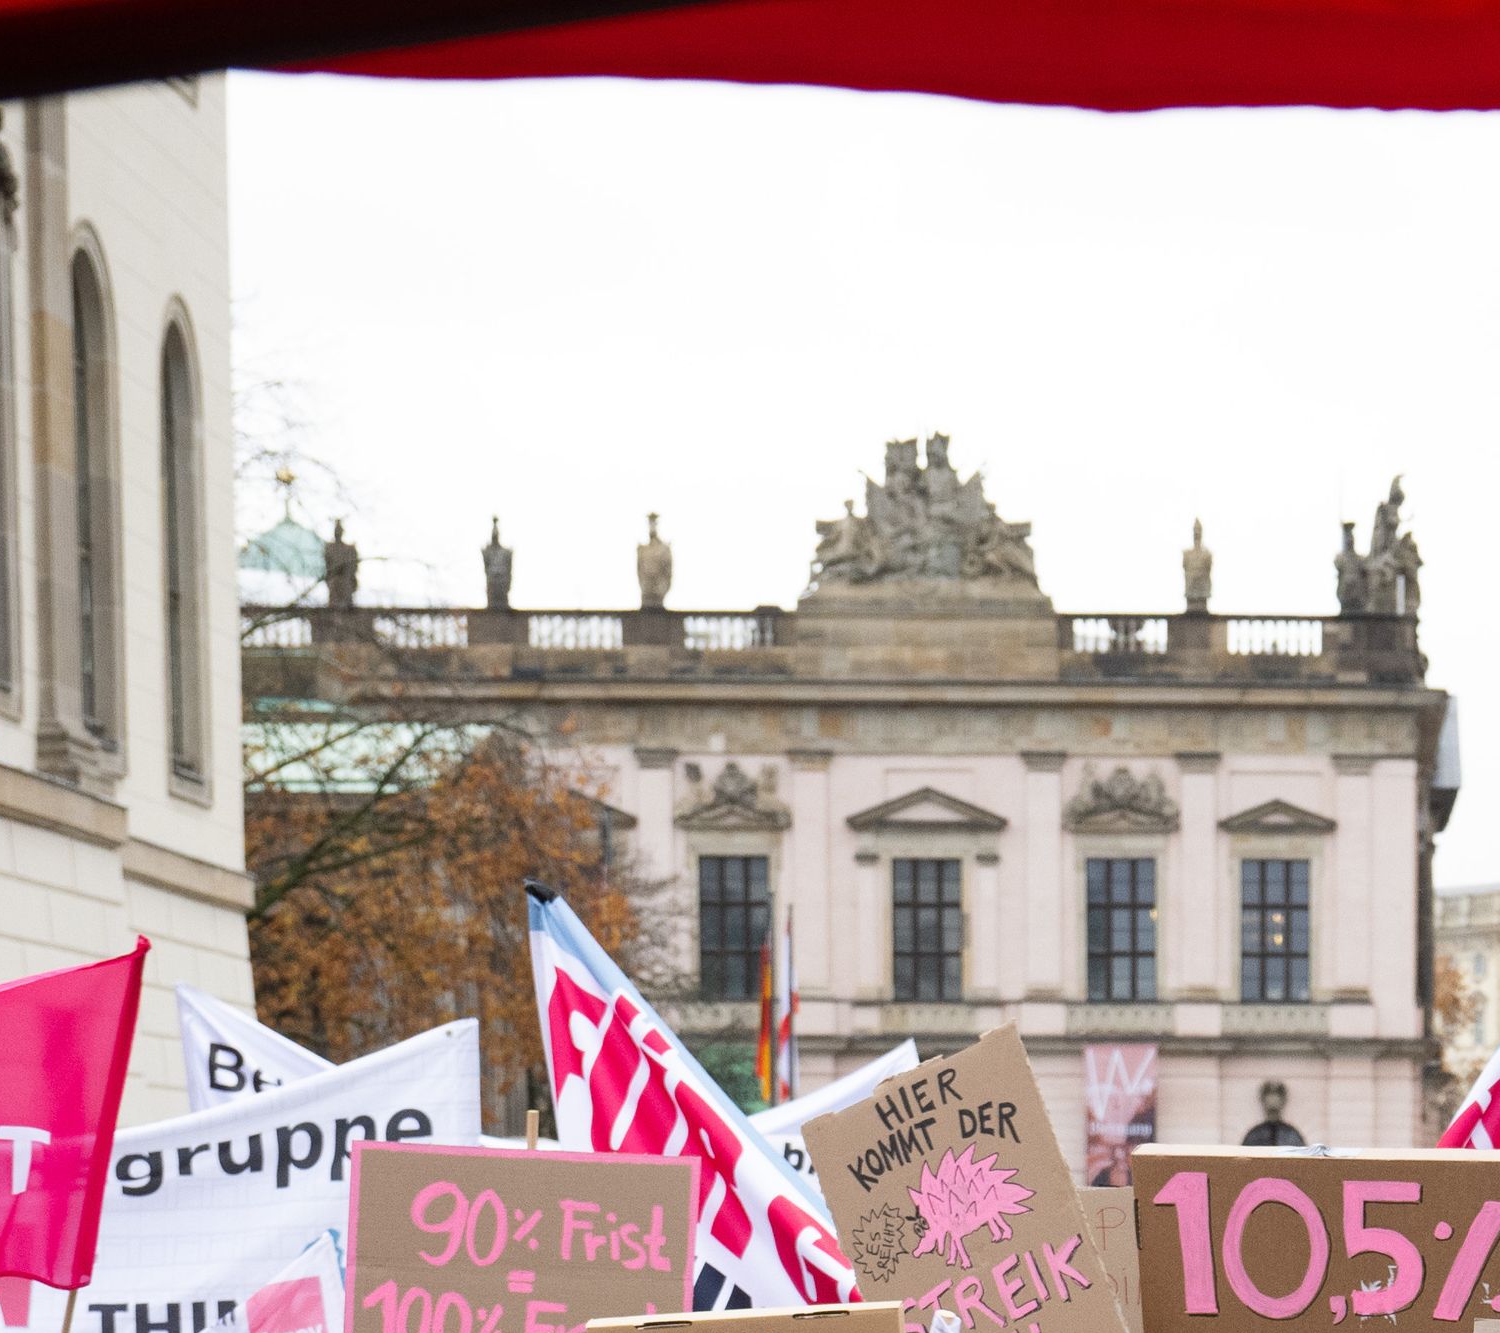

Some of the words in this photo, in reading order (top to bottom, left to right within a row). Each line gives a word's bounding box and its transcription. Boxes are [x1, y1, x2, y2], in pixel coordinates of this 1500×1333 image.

[875, 1068, 964, 1133] HIER
[847, 1117, 937, 1193] KOMMT
[958, 1101, 1021, 1143] DER
[411, 1181, 542, 1266] 90%
[559, 1199, 671, 1272] Frist
